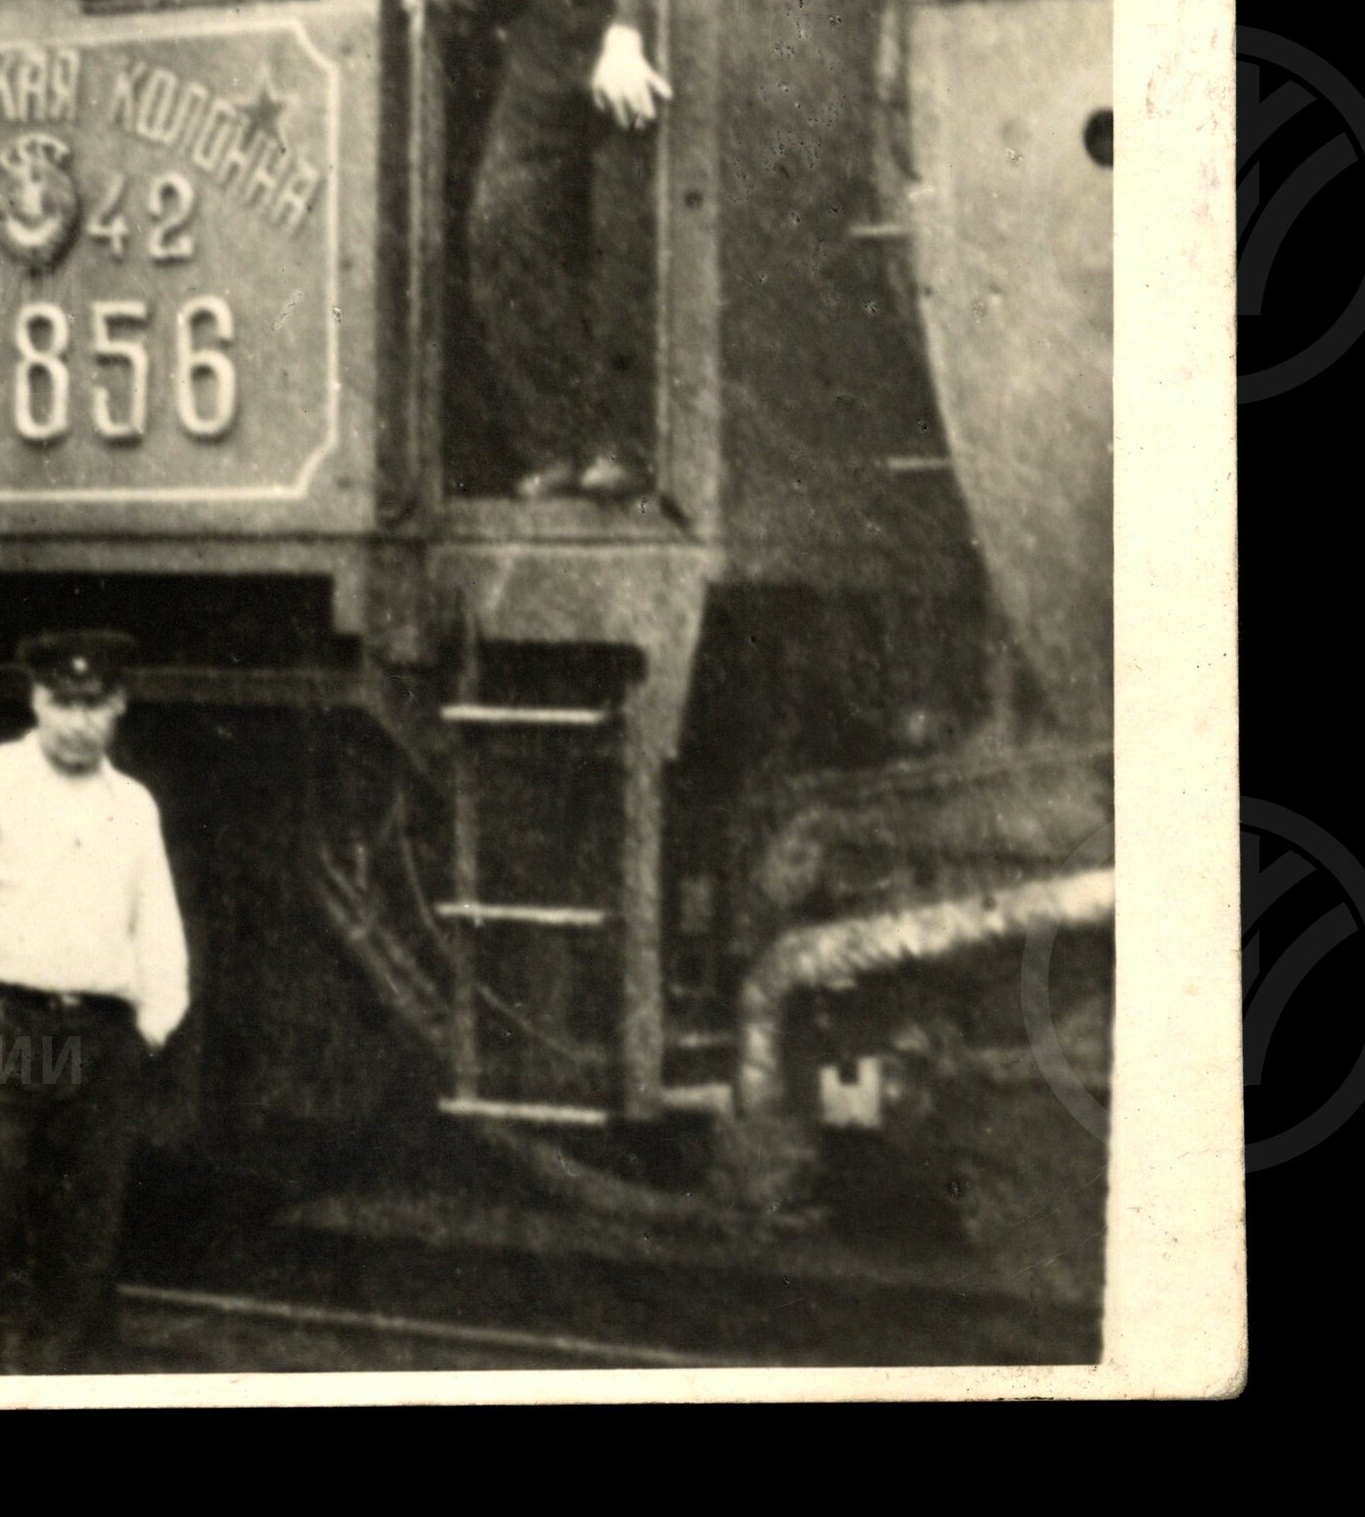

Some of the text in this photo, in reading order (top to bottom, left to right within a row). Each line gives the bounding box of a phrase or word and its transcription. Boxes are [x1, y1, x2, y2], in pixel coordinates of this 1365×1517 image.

[87, 170, 195, 260] 42
[109, 58, 321, 234] КОЛОННА
[13, 296, 238, 443] 856
